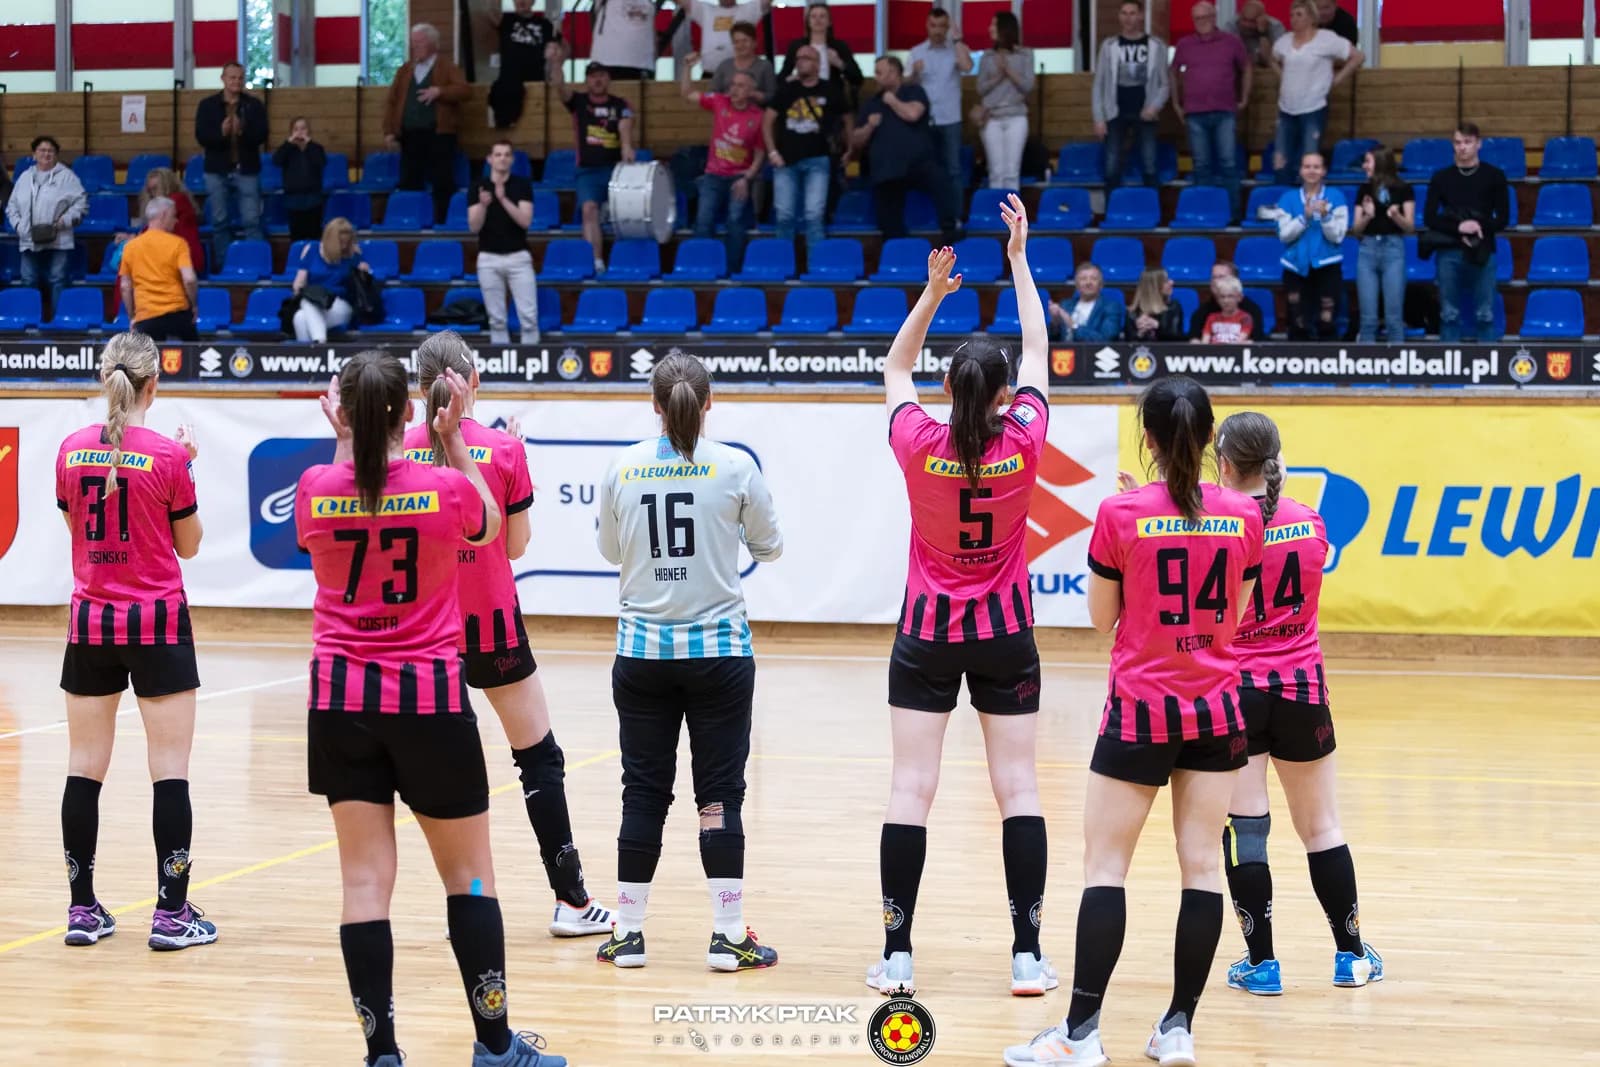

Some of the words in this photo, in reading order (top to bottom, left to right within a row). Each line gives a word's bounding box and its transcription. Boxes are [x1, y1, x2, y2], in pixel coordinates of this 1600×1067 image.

[1165, 349, 1499, 383] www.koronahandball.pl
[81, 451, 148, 467] LEWITAN
[641, 465, 711, 479] LEWIATAN
[948, 458, 1018, 475] LEATAN
[80, 476, 130, 542] 31
[340, 495, 431, 513] LEATAN
[959, 488, 994, 549] 5
[640, 492, 695, 559] 16
[333, 527, 419, 605] 73
[654, 567, 688, 582] HIBNER
[1157, 547, 1229, 625] 94
[1252, 551, 1305, 623] 14
[358, 616, 399, 631] COSTA
